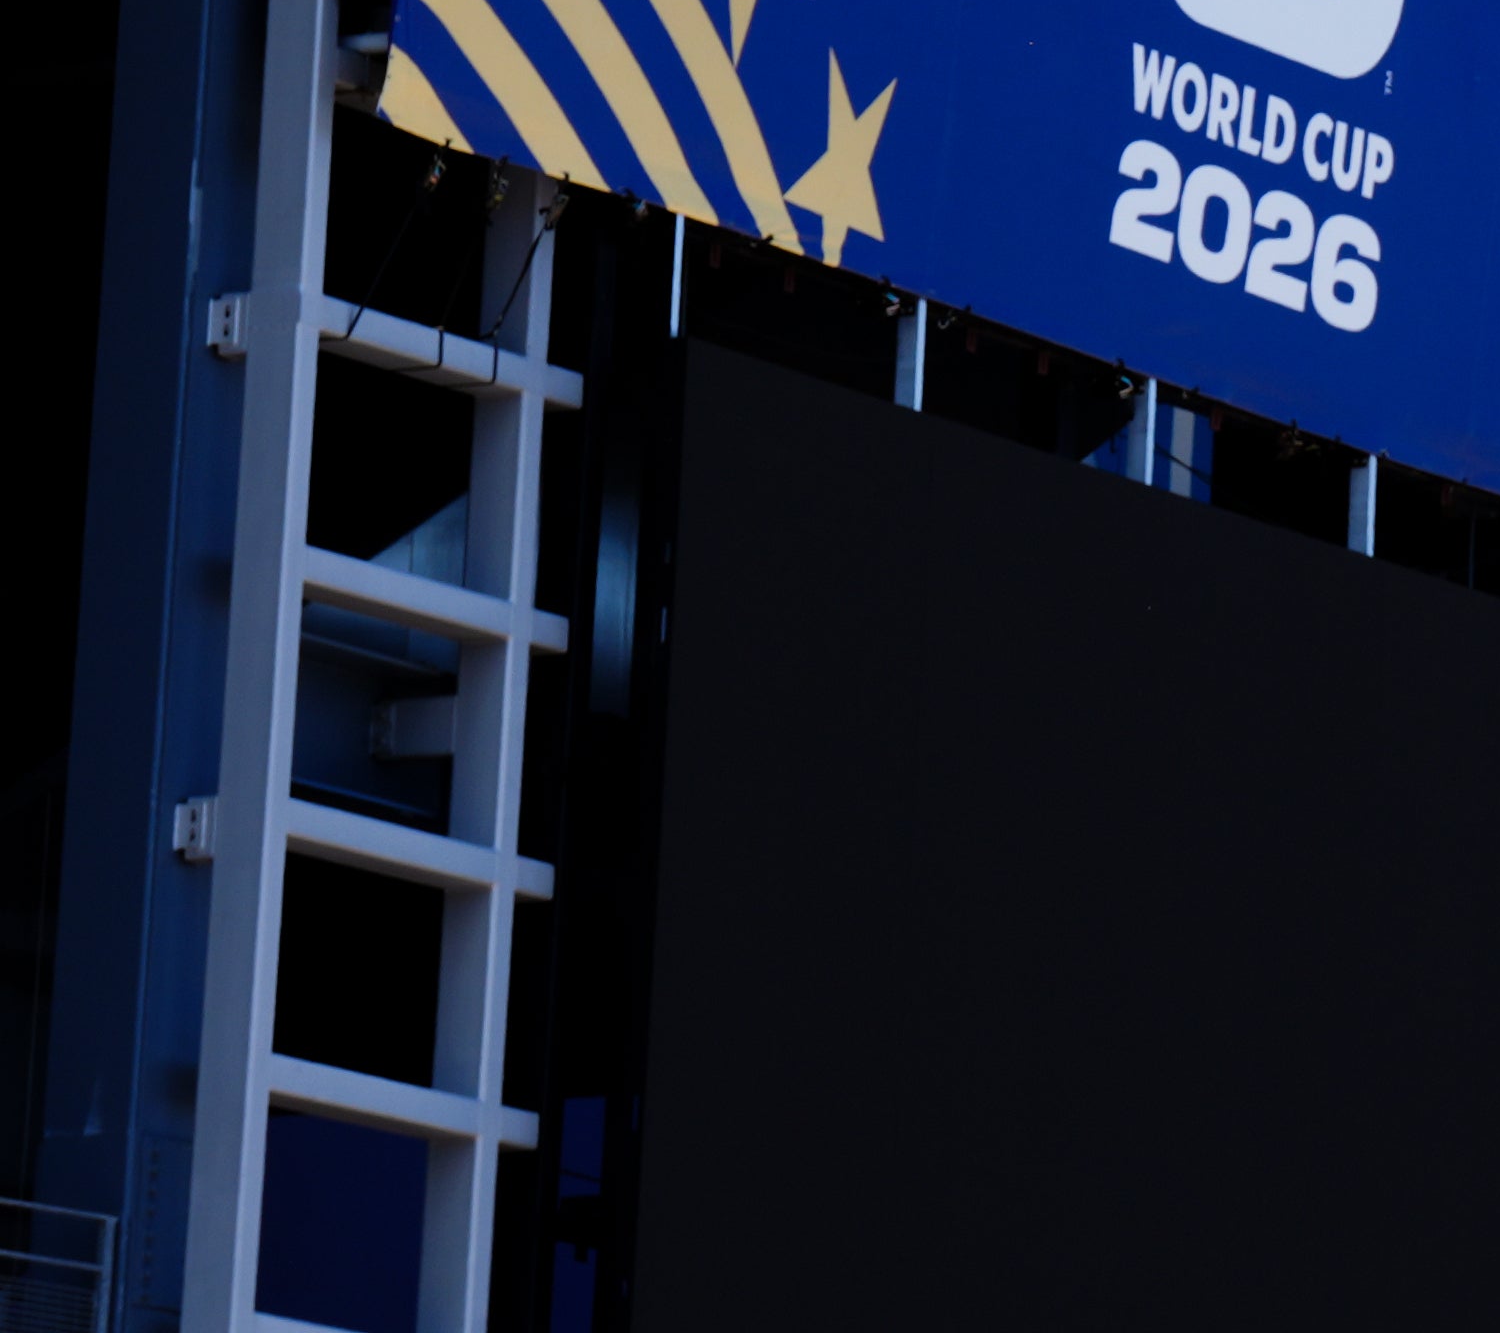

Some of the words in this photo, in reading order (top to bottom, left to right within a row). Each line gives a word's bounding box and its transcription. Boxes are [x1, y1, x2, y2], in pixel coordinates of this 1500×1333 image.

[1133, 42, 1297, 165] WORLD
[1303, 112, 1394, 199] CUP
[1109, 139, 1381, 333] 2026
